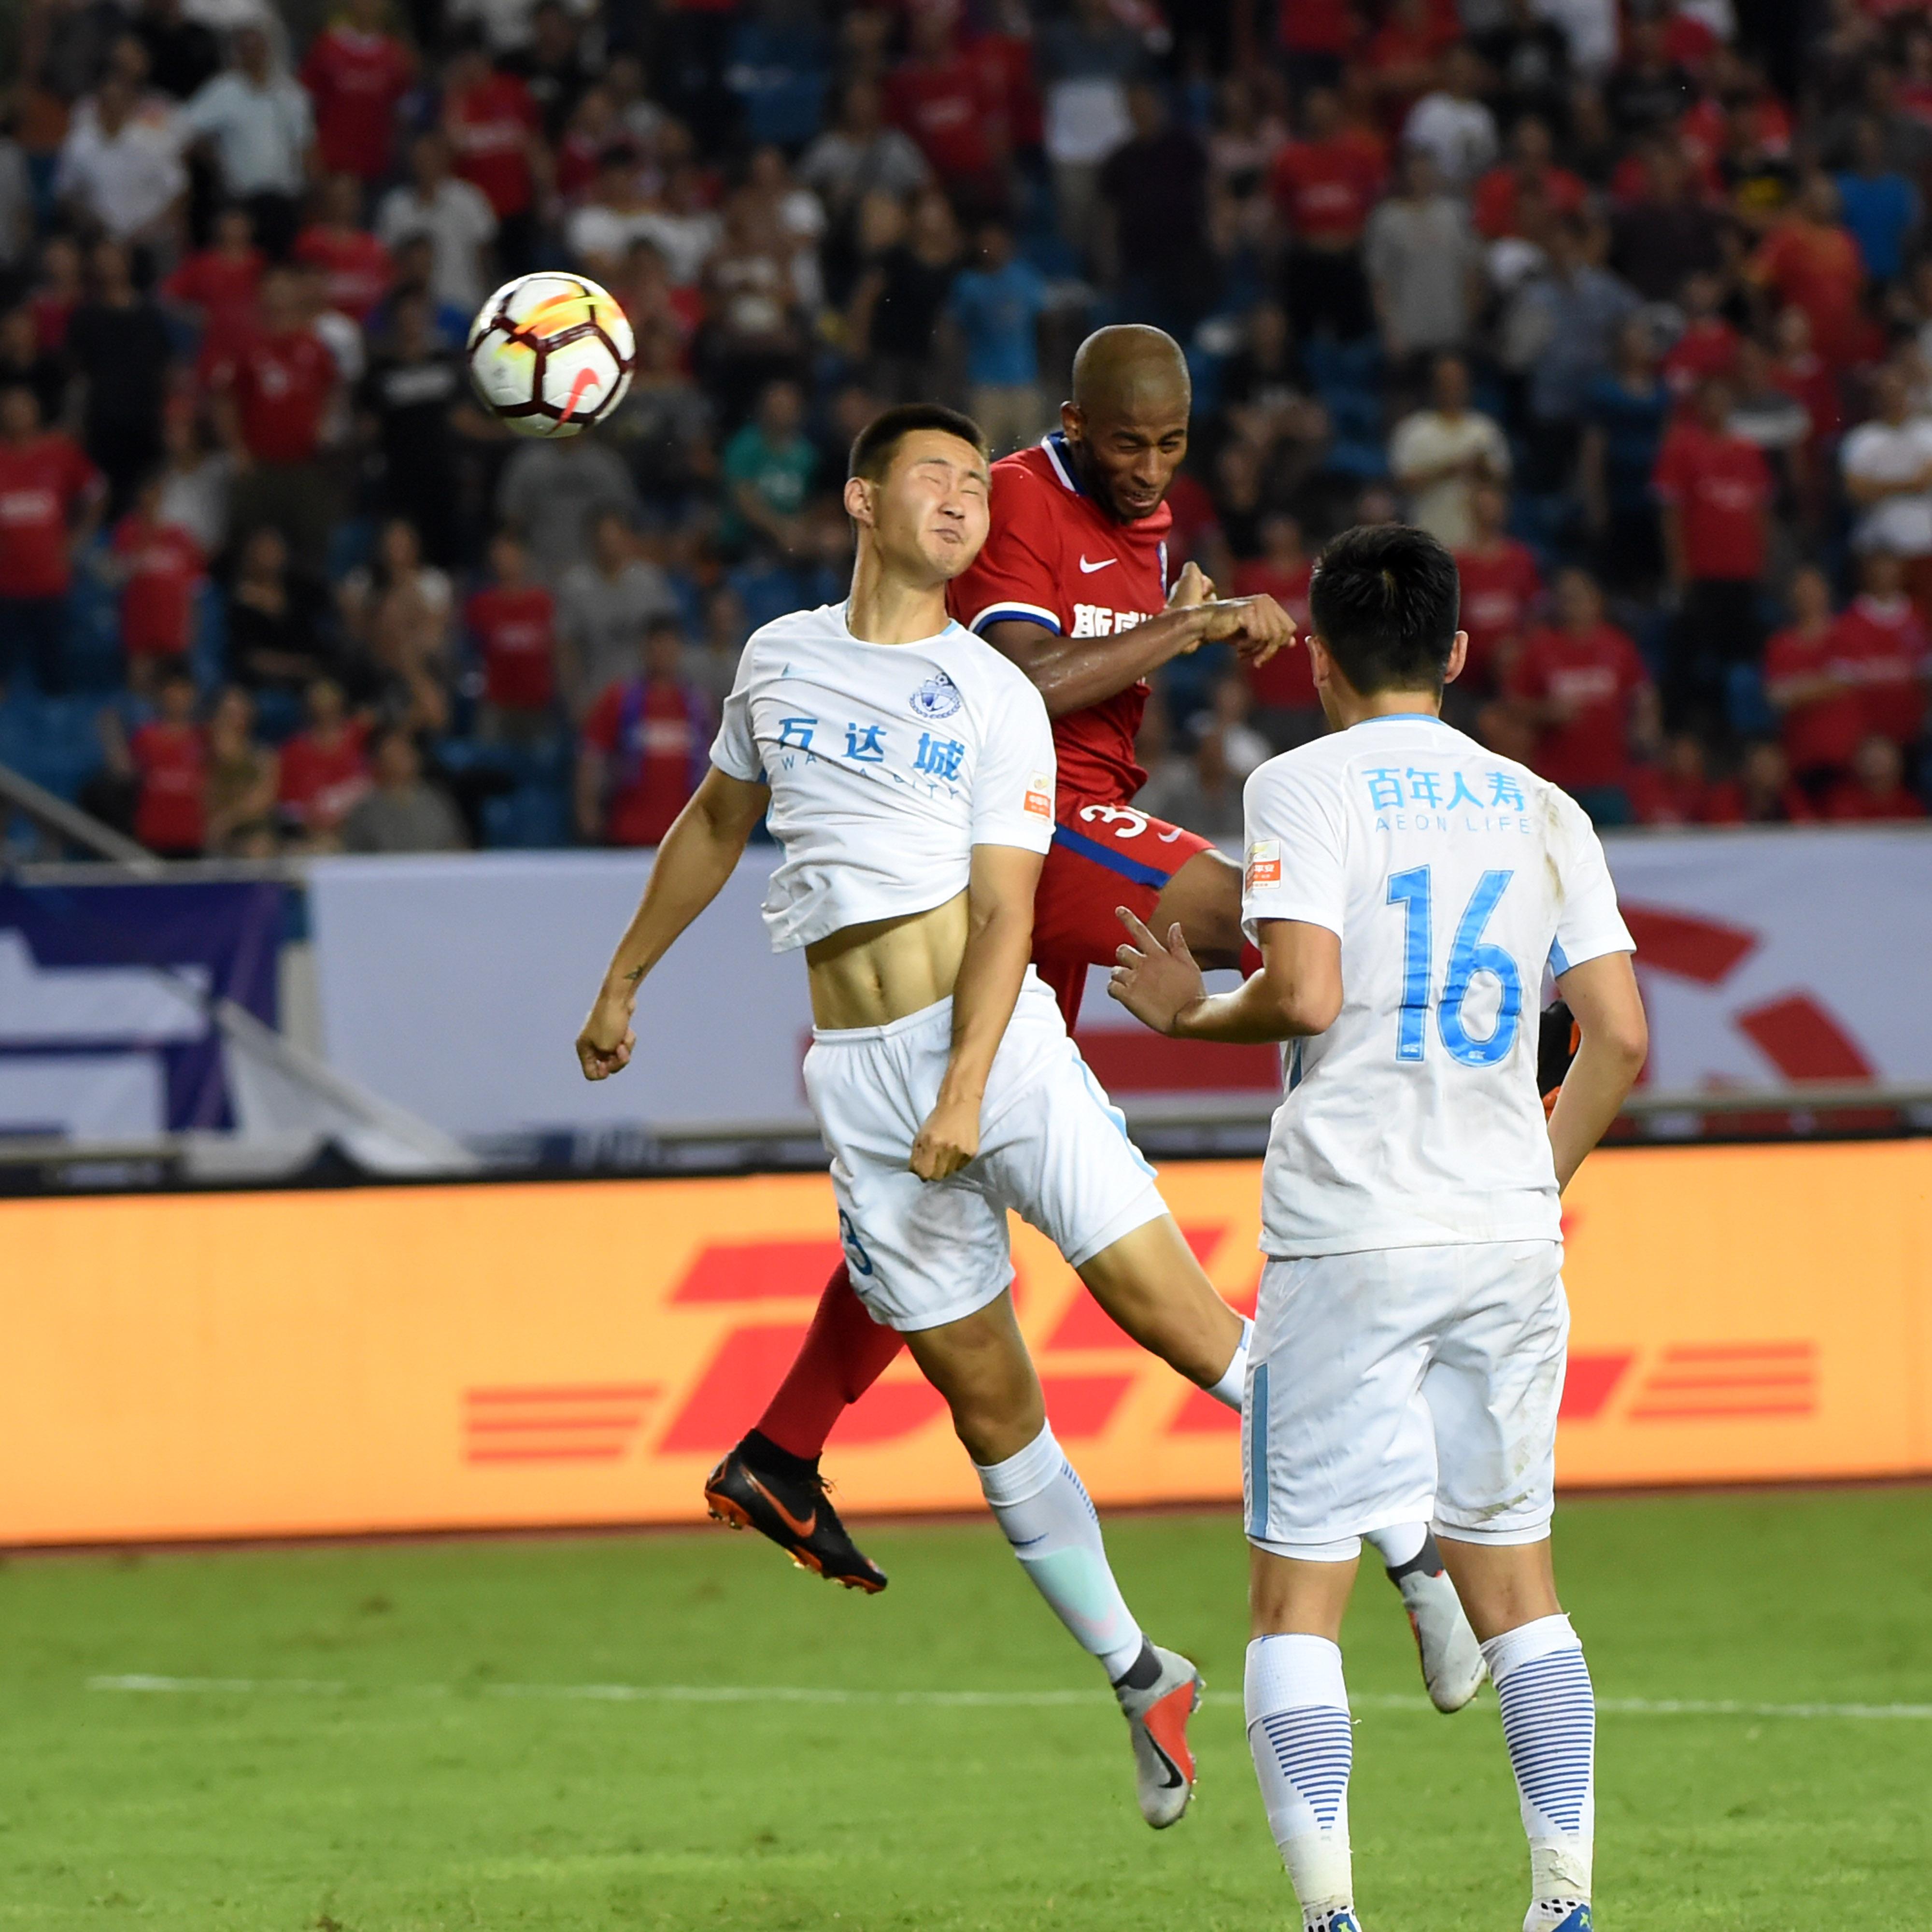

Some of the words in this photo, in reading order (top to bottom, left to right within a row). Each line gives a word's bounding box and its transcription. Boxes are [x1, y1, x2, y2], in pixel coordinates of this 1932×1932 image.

[777, 718, 965, 781] 万达城
[1362, 767, 1524, 812] 百年人寿
[1375, 814, 1448, 832] AEON
[1466, 816, 1531, 834] LIFE
[1386, 864, 1522, 1067] 16
